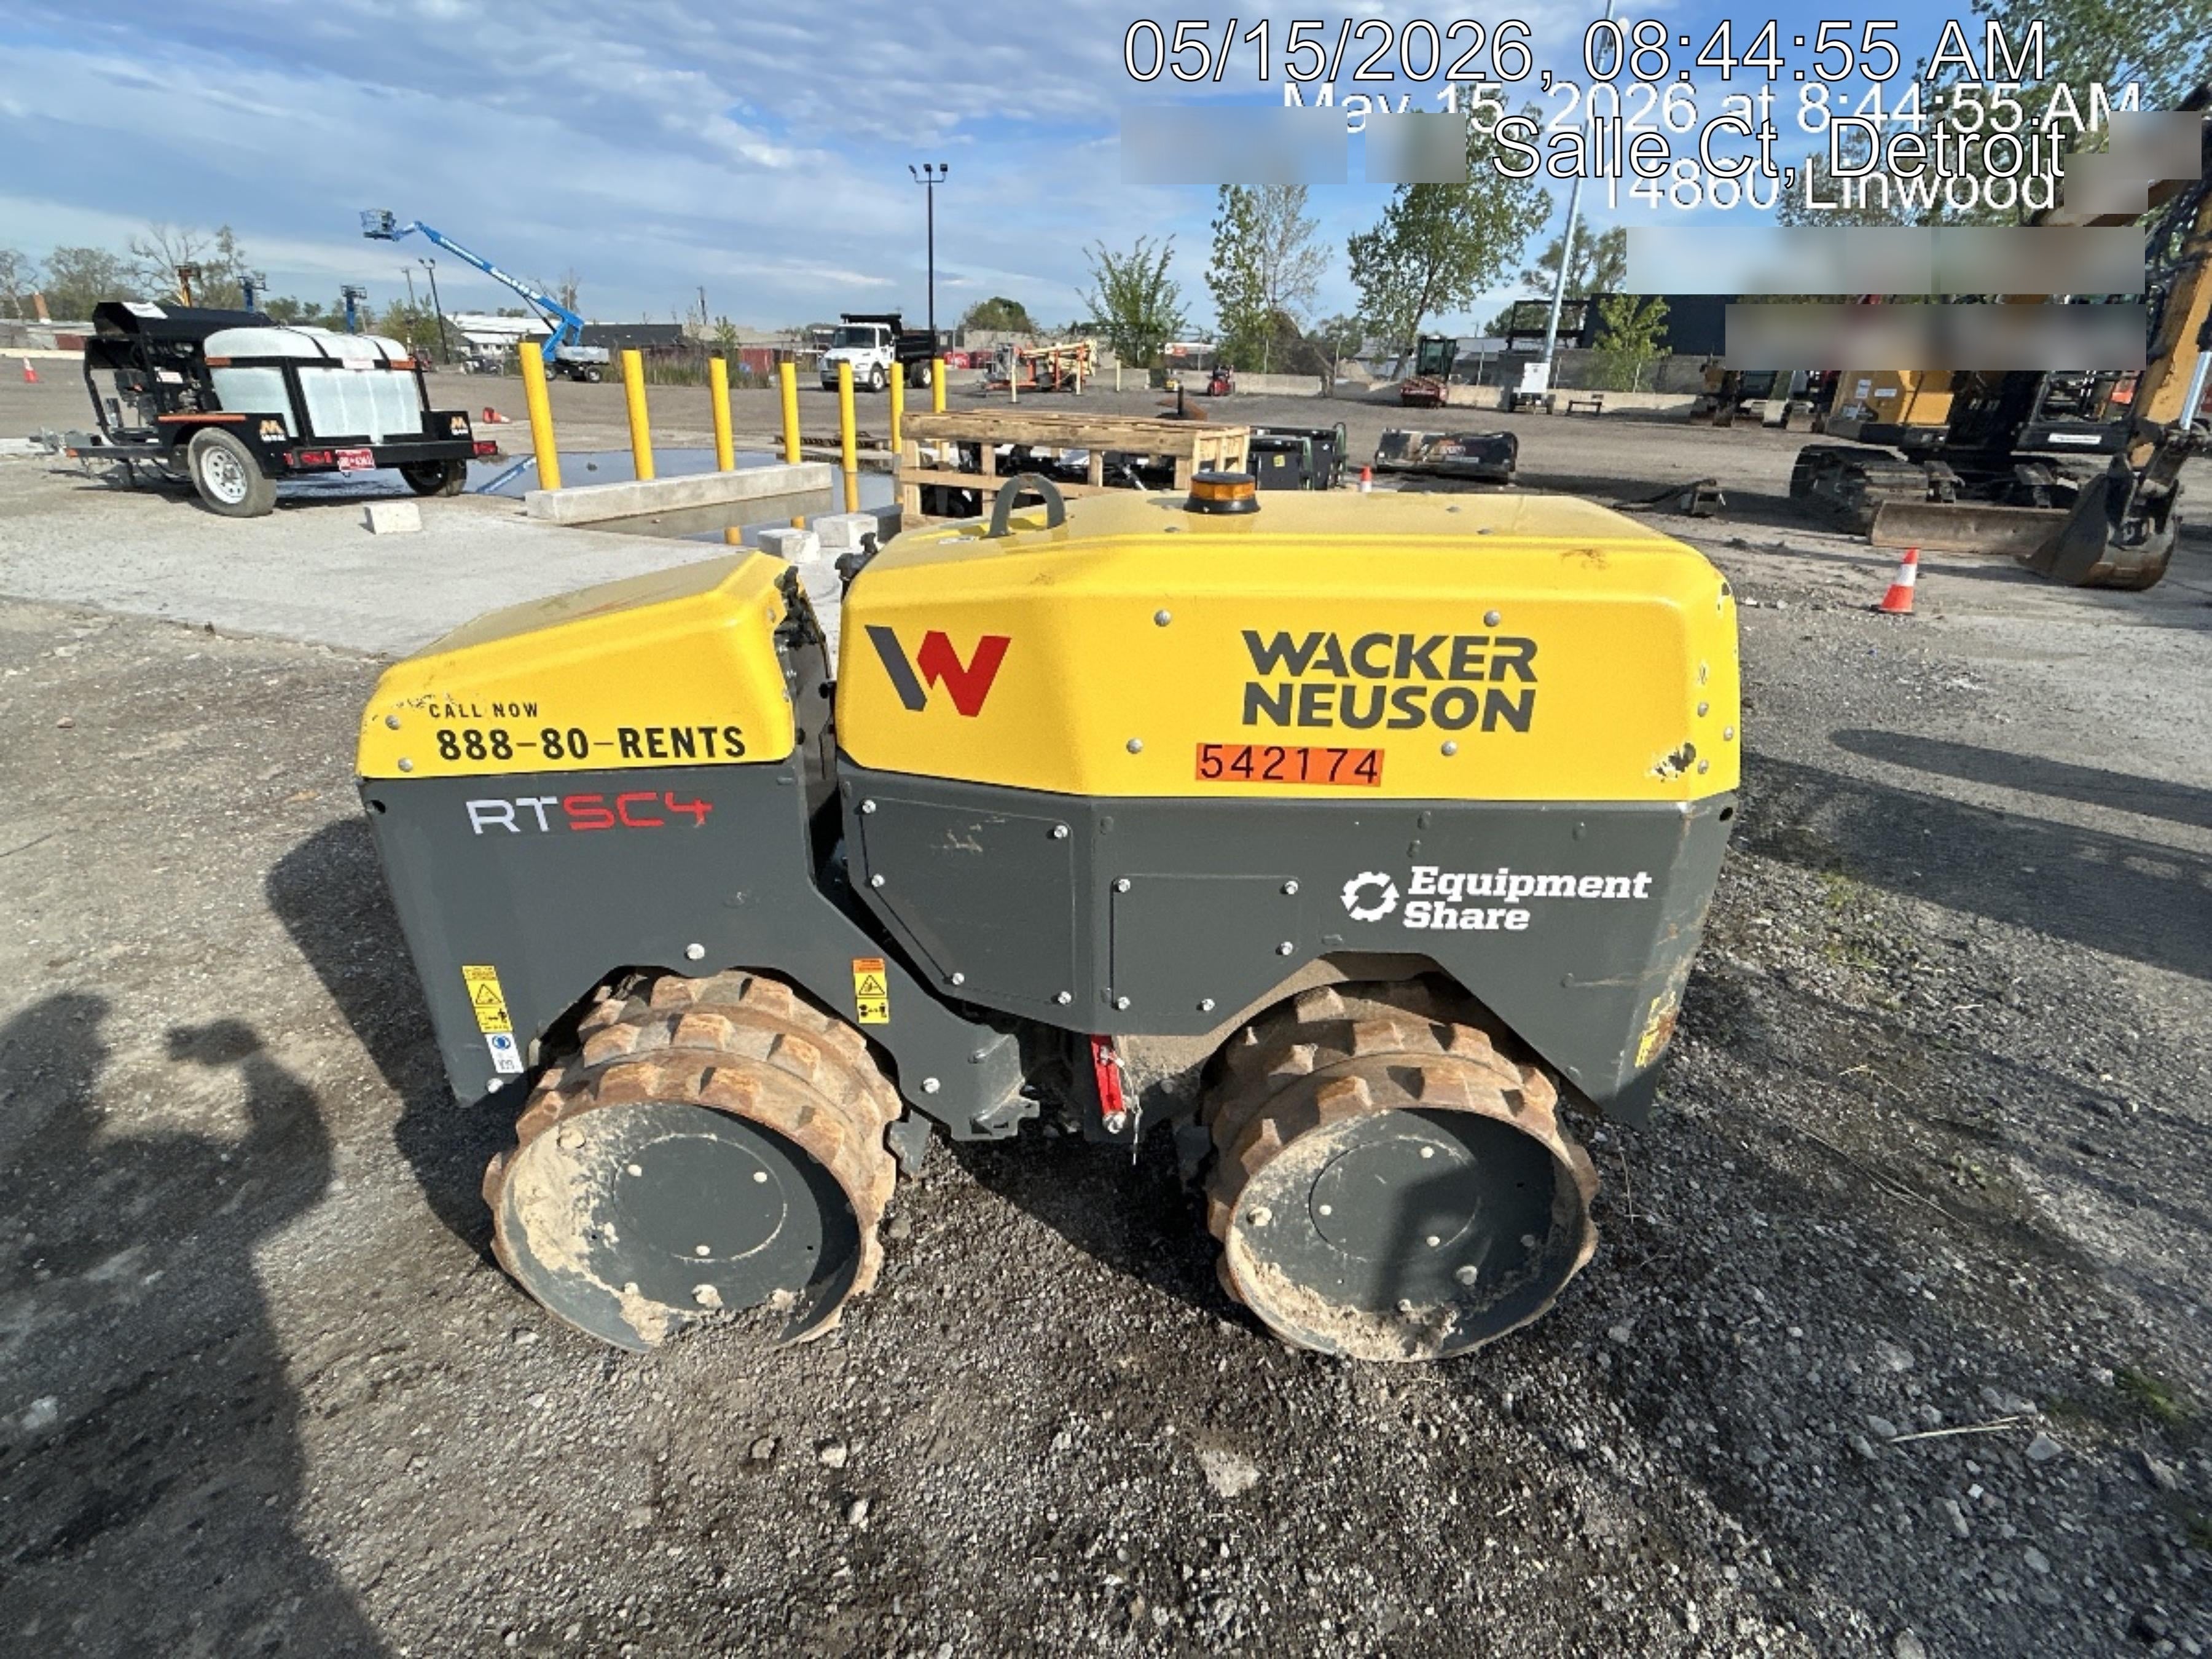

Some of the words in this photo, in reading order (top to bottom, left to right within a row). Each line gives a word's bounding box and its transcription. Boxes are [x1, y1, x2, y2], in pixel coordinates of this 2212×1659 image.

[1241, 630, 1538, 683] WACKER
[428, 702, 482, 718] CALL
[493, 702, 538, 718] NOW
[1242, 682, 1536, 733] NEUSON
[436, 726, 746, 761] 888-80-RENTS
[1200, 744, 1379, 783] 542174
[465, 791, 712, 834] RTSC4
[1408, 866, 1652, 903] Equipment
[1403, 900, 1531, 931] Share
